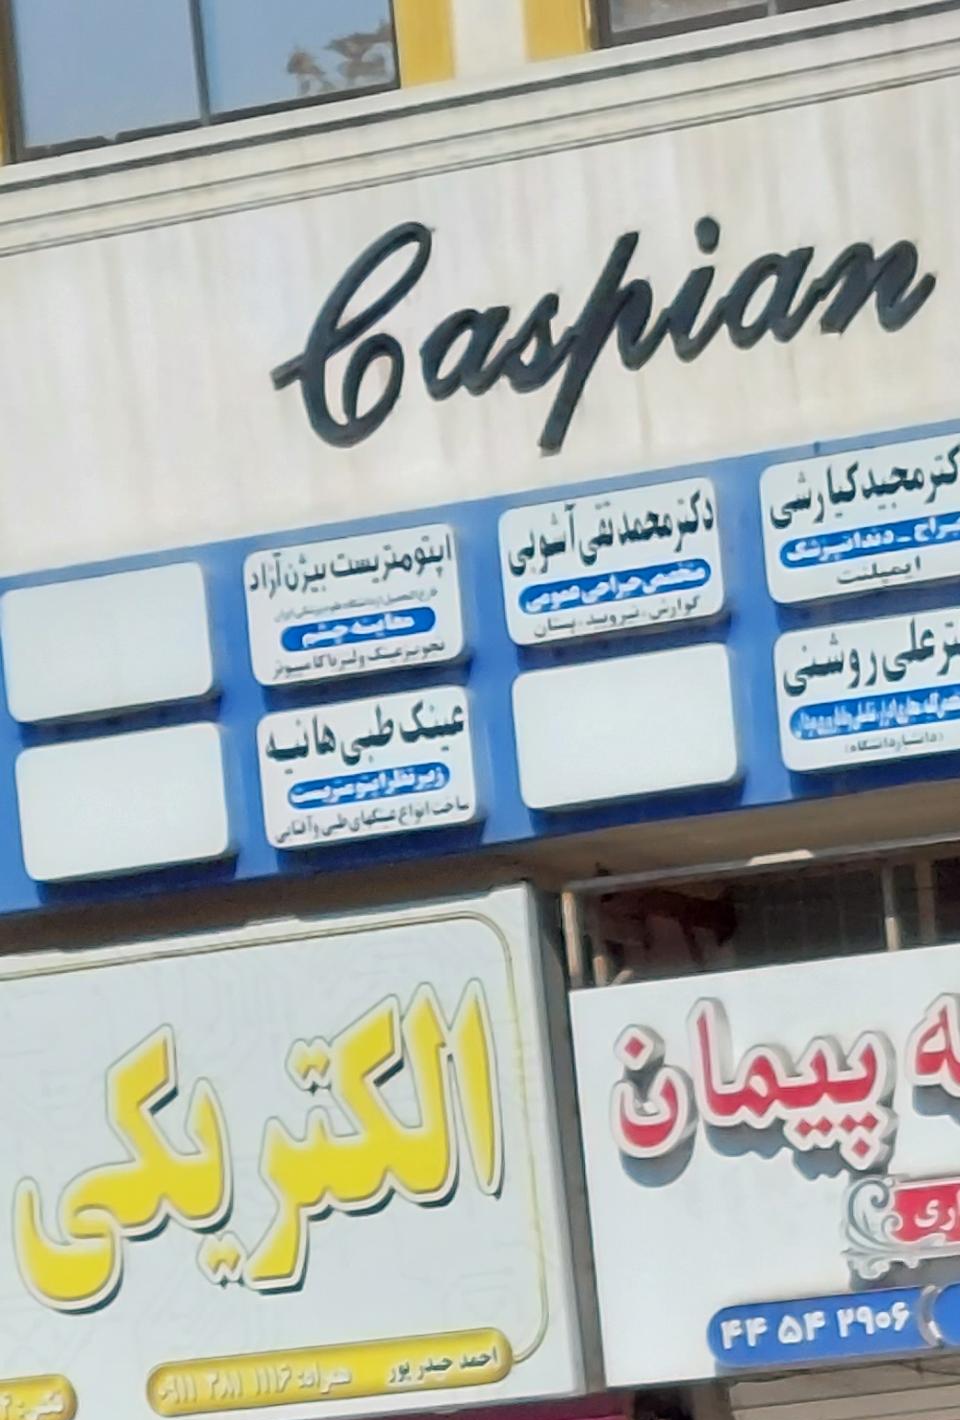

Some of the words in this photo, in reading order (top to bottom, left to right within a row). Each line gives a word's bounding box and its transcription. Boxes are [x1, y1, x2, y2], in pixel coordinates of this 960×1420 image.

[269, 215, 937, 456] Caspian
[861, 464, 925, 512] مجید
[579, 500, 615, 567] تقی
[617, 509, 673, 546] محمد
[673, 489, 715, 553] دکتر
[786, 527, 895, 563] دندانپزشک
[248, 550, 282, 600] آزاد
[285, 552, 327, 594] بیژن
[330, 533, 452, 584] اپتومتریست
[642, 562, 706, 596] متخصص
[580, 573, 643, 605] جراحی
[302, 624, 349, 650] چشم
[351, 611, 416, 639] معاینه
[882, 616, 935, 683] علی
[782, 632, 878, 698] روشنی
[265, 713, 337, 775] هانیه
[340, 703, 395, 767] طبی
[399, 700, 465, 752] عینک
[290, 771, 387, 804] اپتومتریست
[415, 765, 446, 791] زیر
[612, 997, 890, 1170] پیمان
[15, 977, 503, 1313] الکتریکی
[720, 1316, 768, 1349] ۴۴
[777, 1310, 825, 1345] ۵۴
